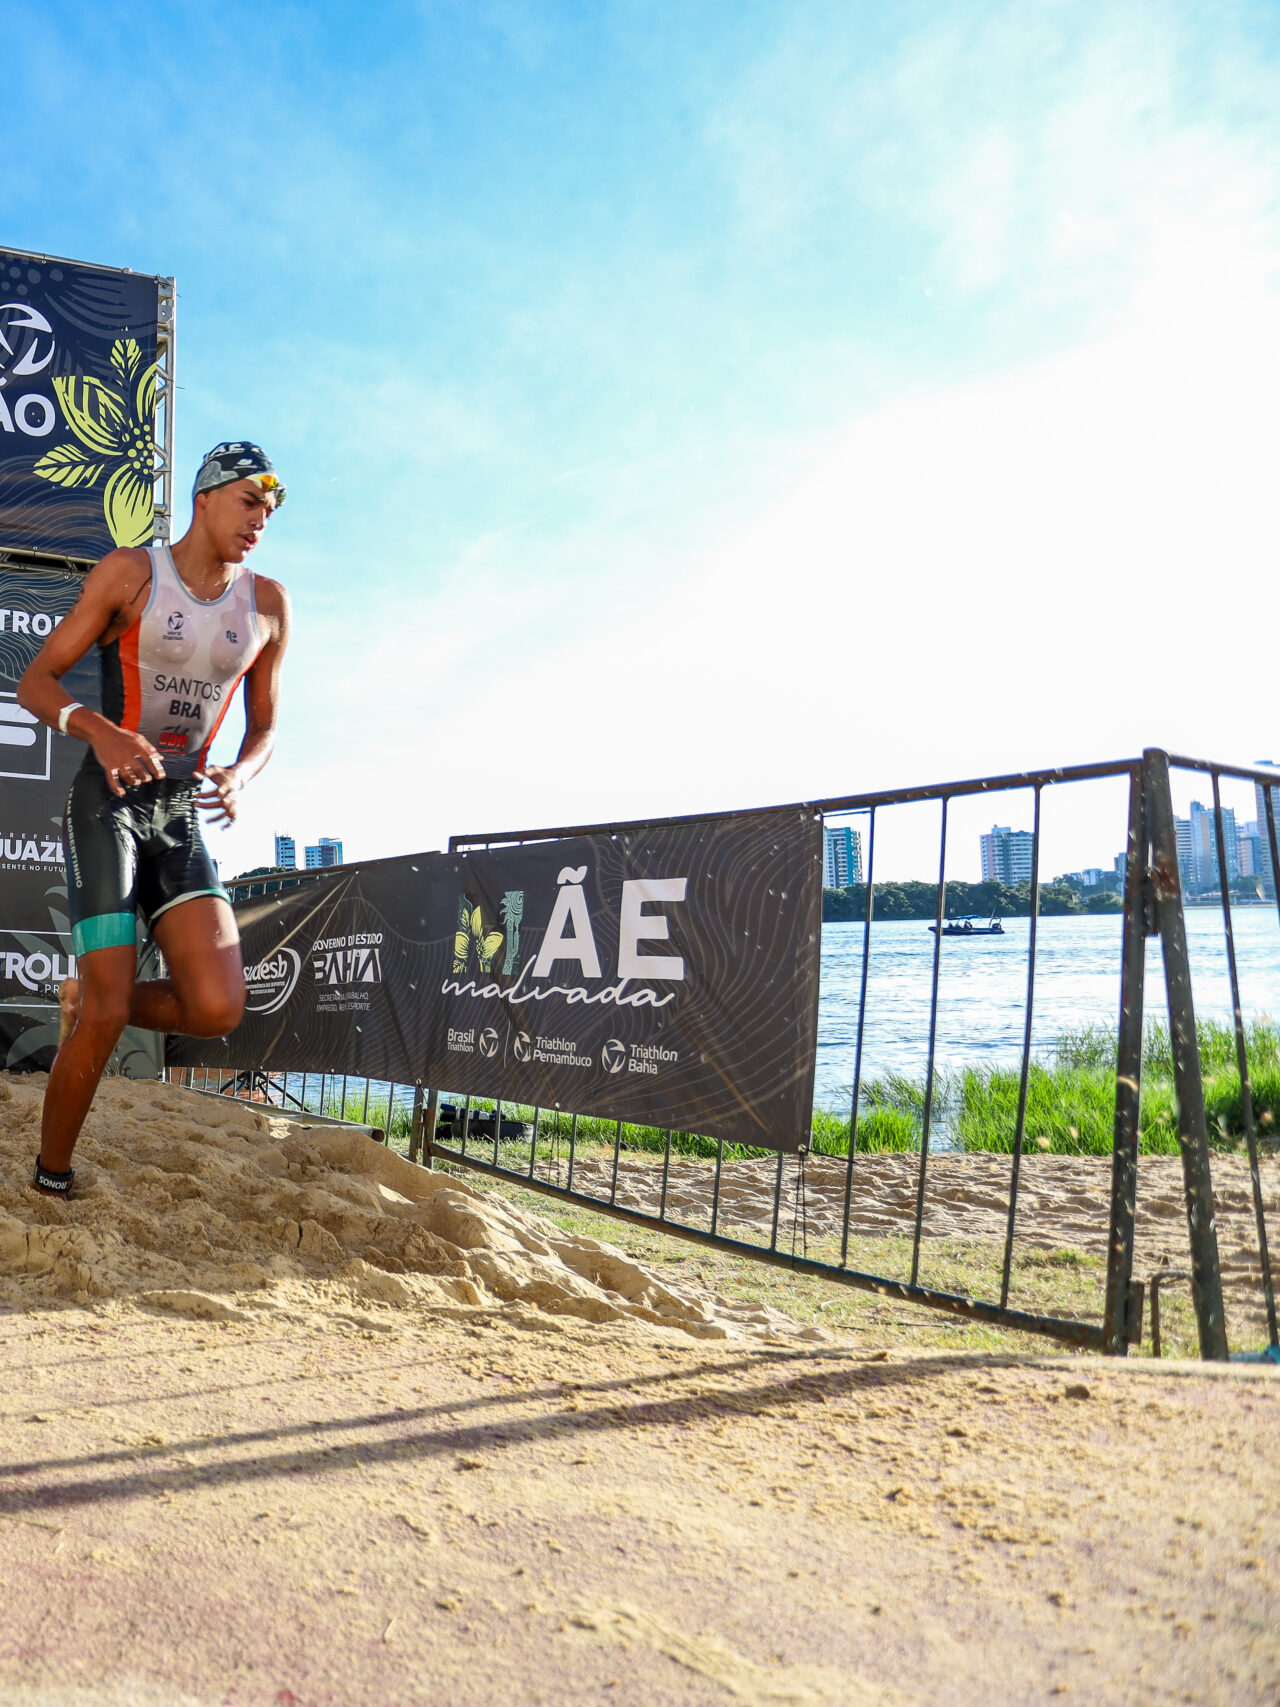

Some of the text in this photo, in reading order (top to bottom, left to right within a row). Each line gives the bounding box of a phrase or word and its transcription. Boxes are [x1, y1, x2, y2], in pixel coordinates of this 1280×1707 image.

[153, 674, 222, 702] SANTOS
[168, 699, 202, 720] BRA
[67, 817, 83, 888] ROBERTINHO
[452, 865, 688, 981] MÃE
[312, 936, 346, 952] GOVERNO
[243, 953, 288, 982] sudesb
[312, 948, 382, 986] BAHIA
[441, 953, 676, 1007] malvada
[447, 1028, 474, 1043] Brasil
[535, 1036, 576, 1052] Triathlon
[447, 1041, 474, 1053] Triathlon
[629, 1043, 678, 1062] Triathlon
[532, 1049, 592, 1067] Pernambuco
[628, 1059, 658, 1075] Bahia
